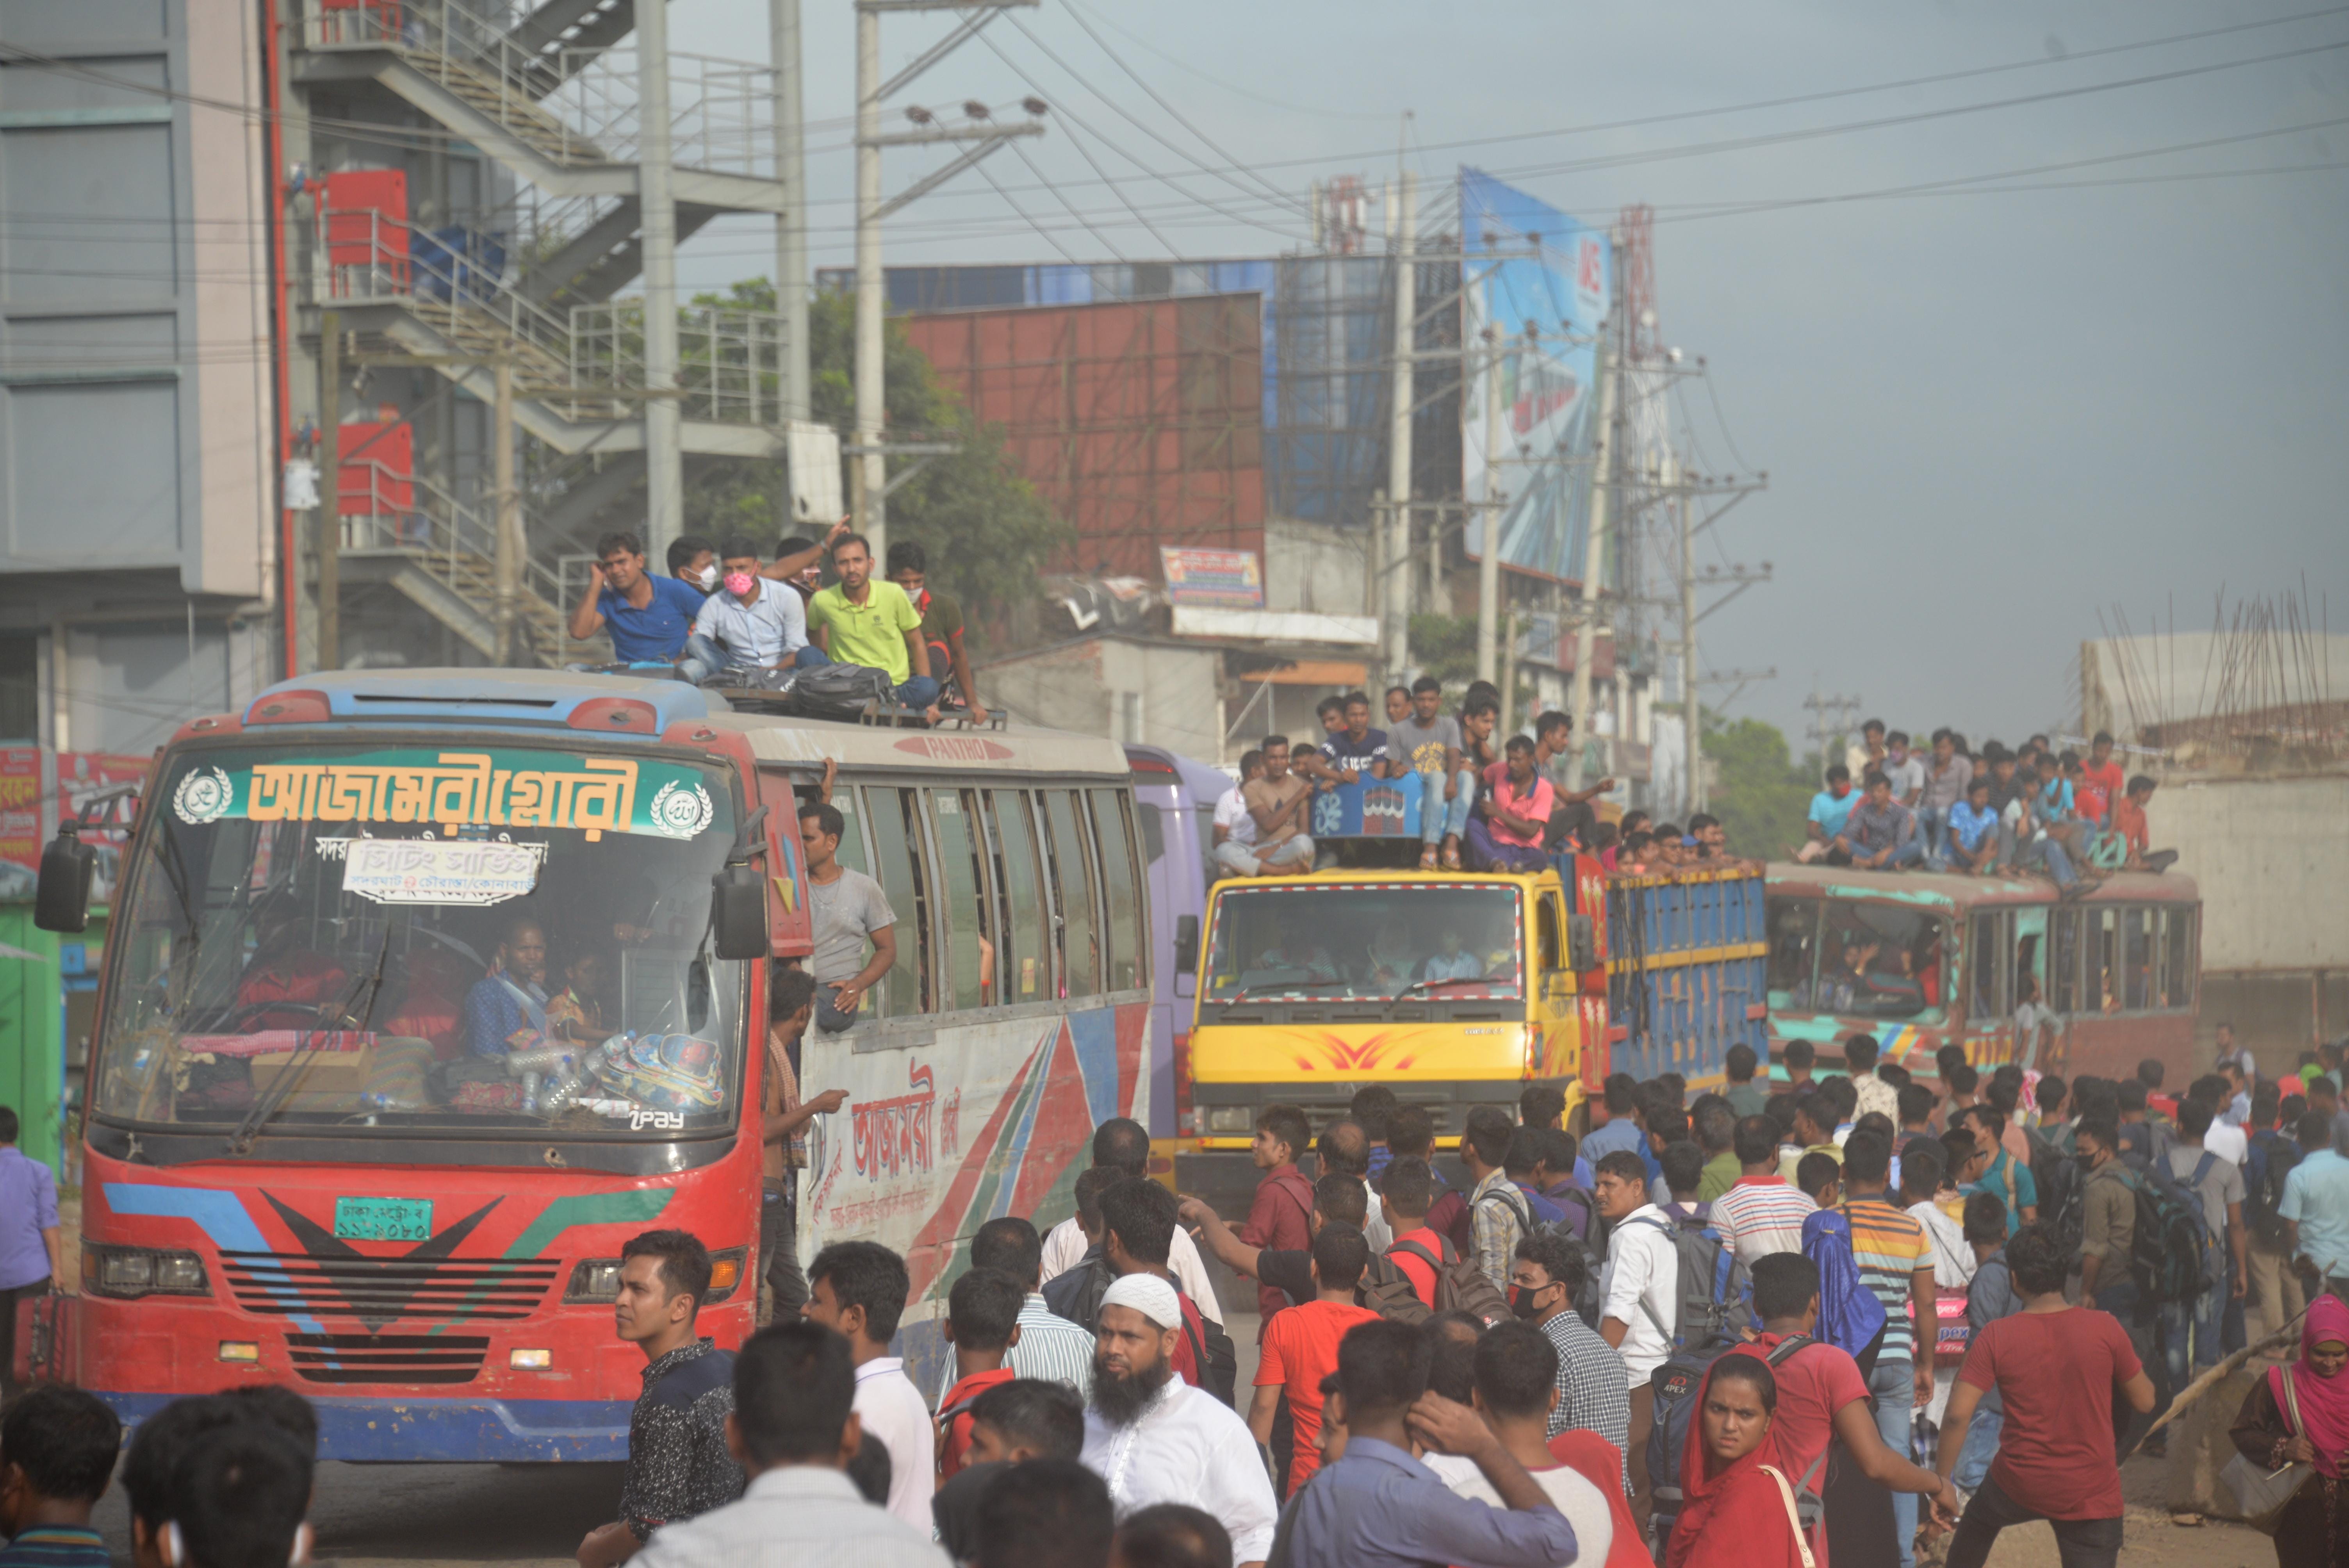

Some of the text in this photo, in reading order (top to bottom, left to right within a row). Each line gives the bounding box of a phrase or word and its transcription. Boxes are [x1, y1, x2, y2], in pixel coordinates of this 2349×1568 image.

[928, 738, 986, 760] PANTHO
[1936, 1305, 1957, 1315] pex
[1938, 1326, 1971, 1342] pex
[1664, 1384, 1686, 1394] APEX
